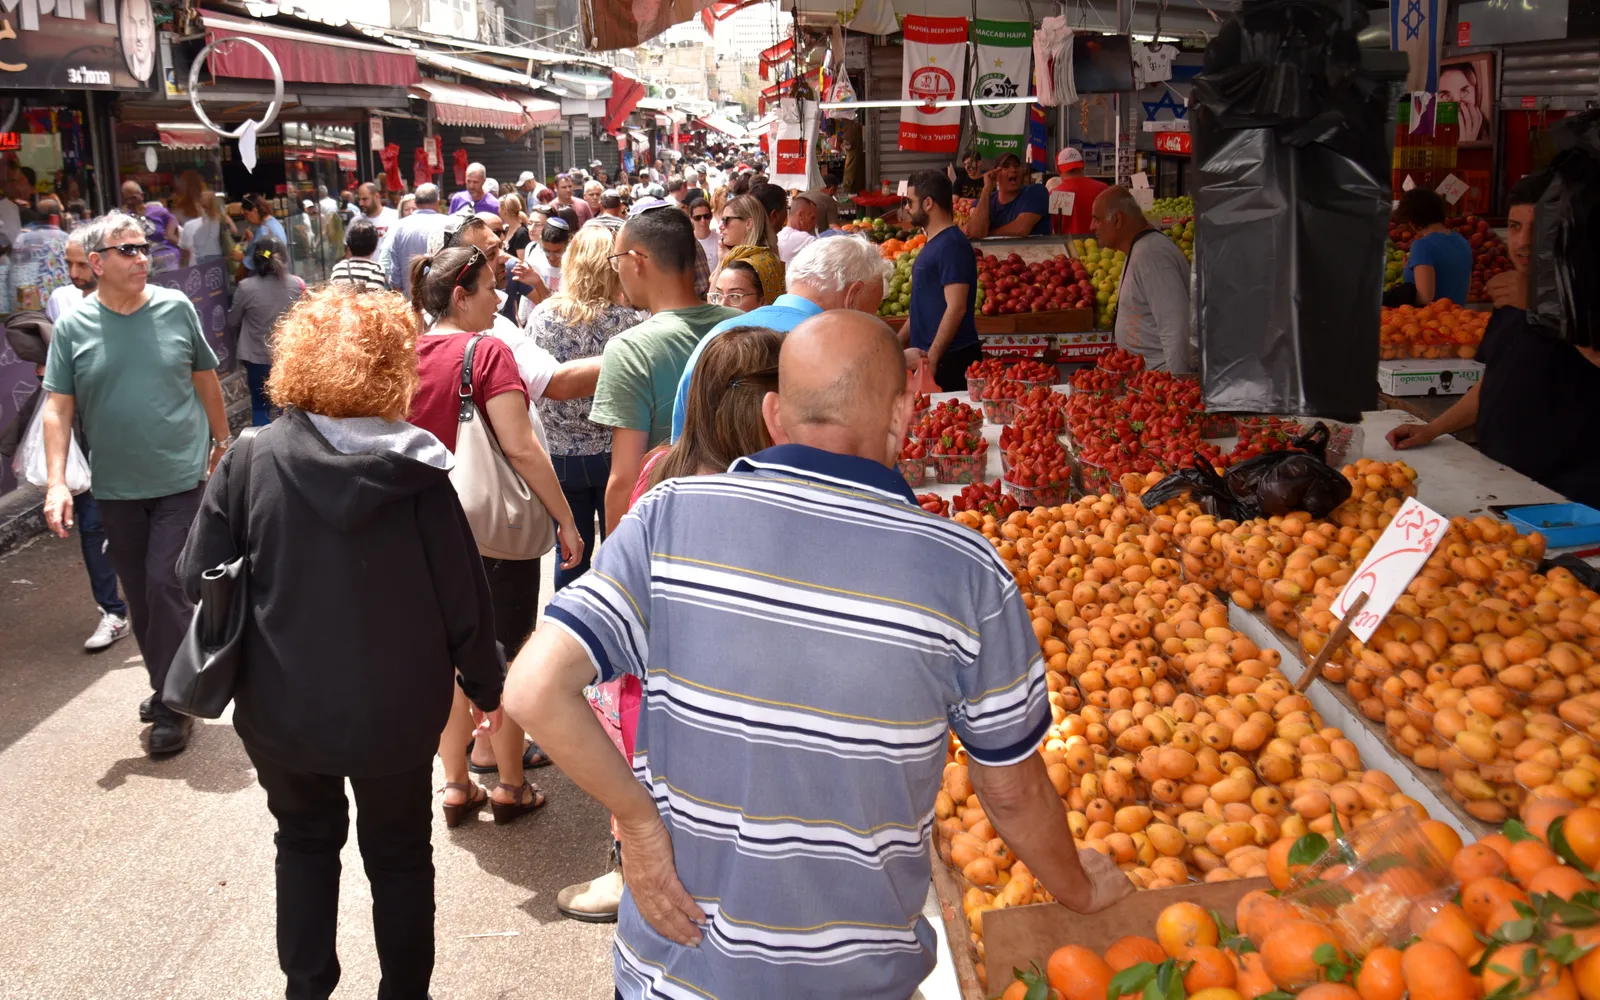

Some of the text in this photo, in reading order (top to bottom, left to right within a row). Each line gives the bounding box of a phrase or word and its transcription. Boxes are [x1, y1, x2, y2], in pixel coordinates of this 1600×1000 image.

[907, 24, 930, 33] HAPOEL
[945, 25, 964, 34] SHEVA
[975, 28, 1027, 39] MACCABI HAIFA
[902, 131, 956, 141] הפועל באר שבע
[993, 139, 1018, 148] מכבי
[1400, 375, 1435, 384] Avocado
